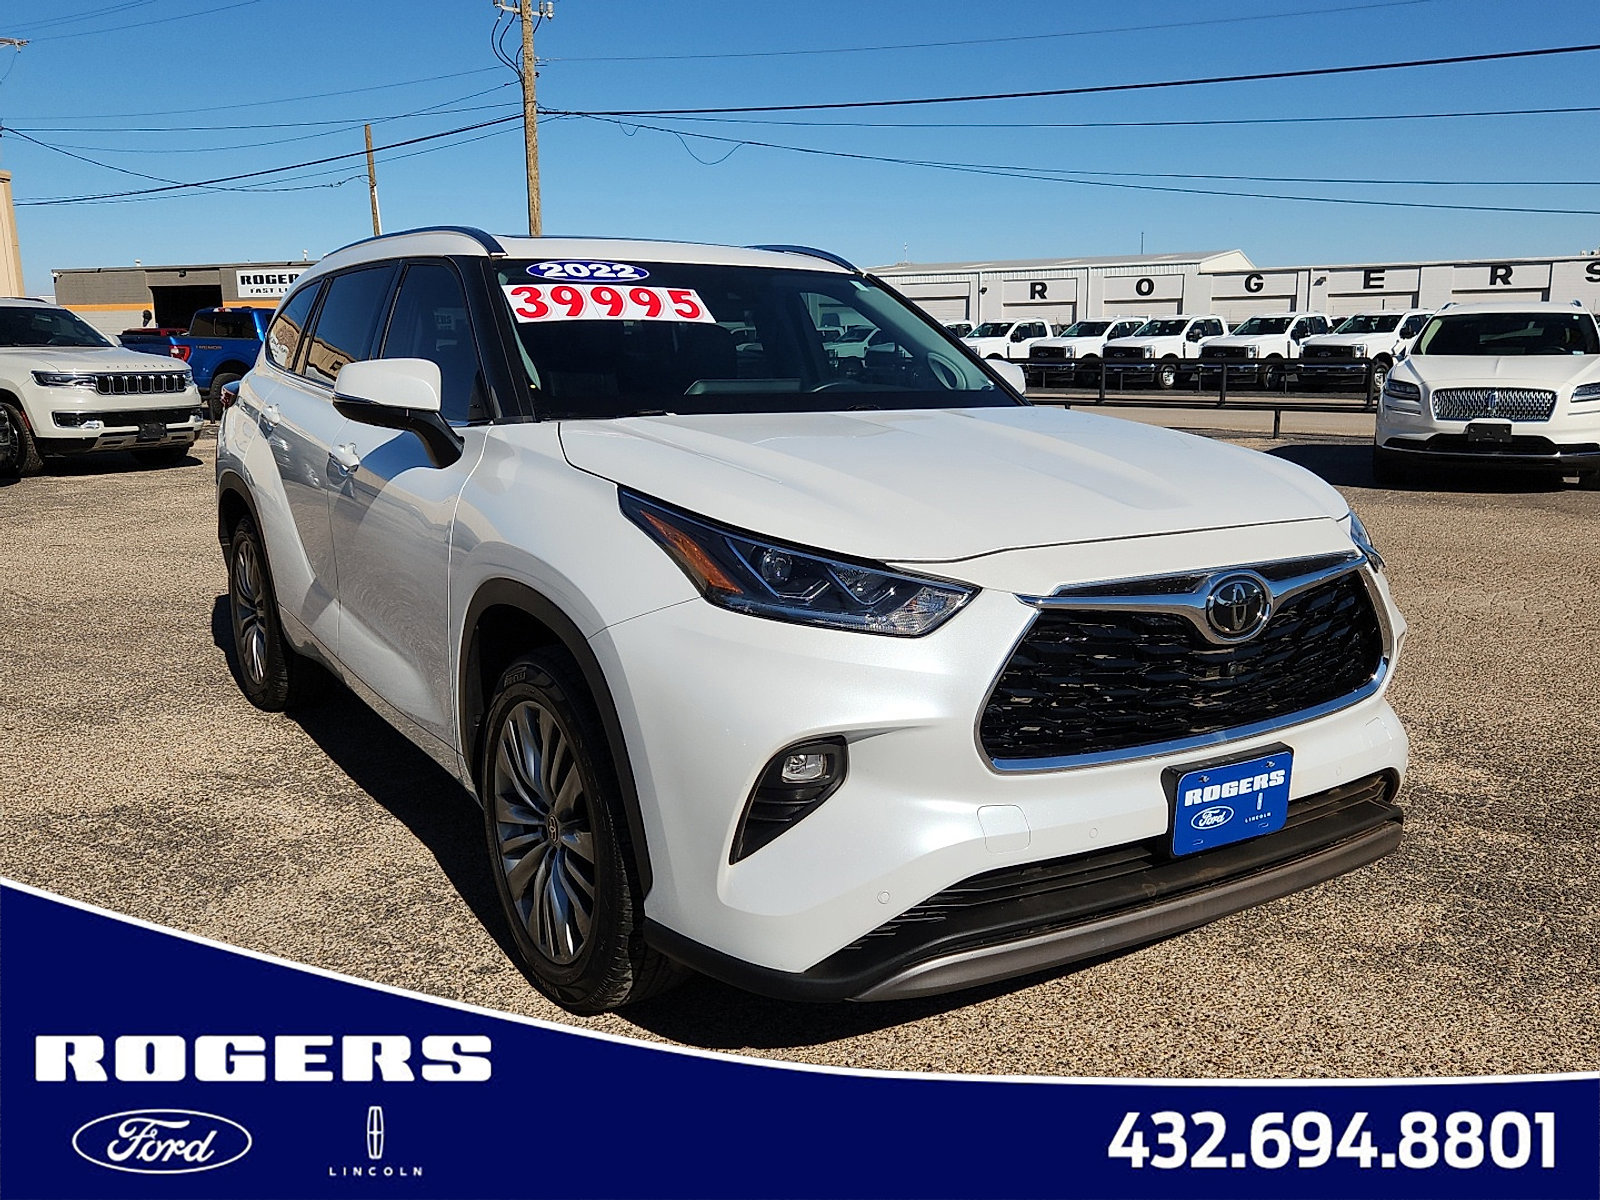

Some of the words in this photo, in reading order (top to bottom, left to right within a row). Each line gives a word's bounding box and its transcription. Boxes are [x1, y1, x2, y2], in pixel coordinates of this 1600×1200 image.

[240, 273, 300, 286] ROGER
[538, 263, 641, 278] 2022
[1030, 282, 1048, 300] R
[1244, 273, 1264, 293] G
[1363, 269, 1386, 289] E
[1489, 265, 1513, 286] R
[510, 285, 705, 320] 39995
[1184, 769, 1286, 807] ROGERS
[1198, 809, 1226, 827] Ford
[1244, 812, 1272, 824] LINCOLN
